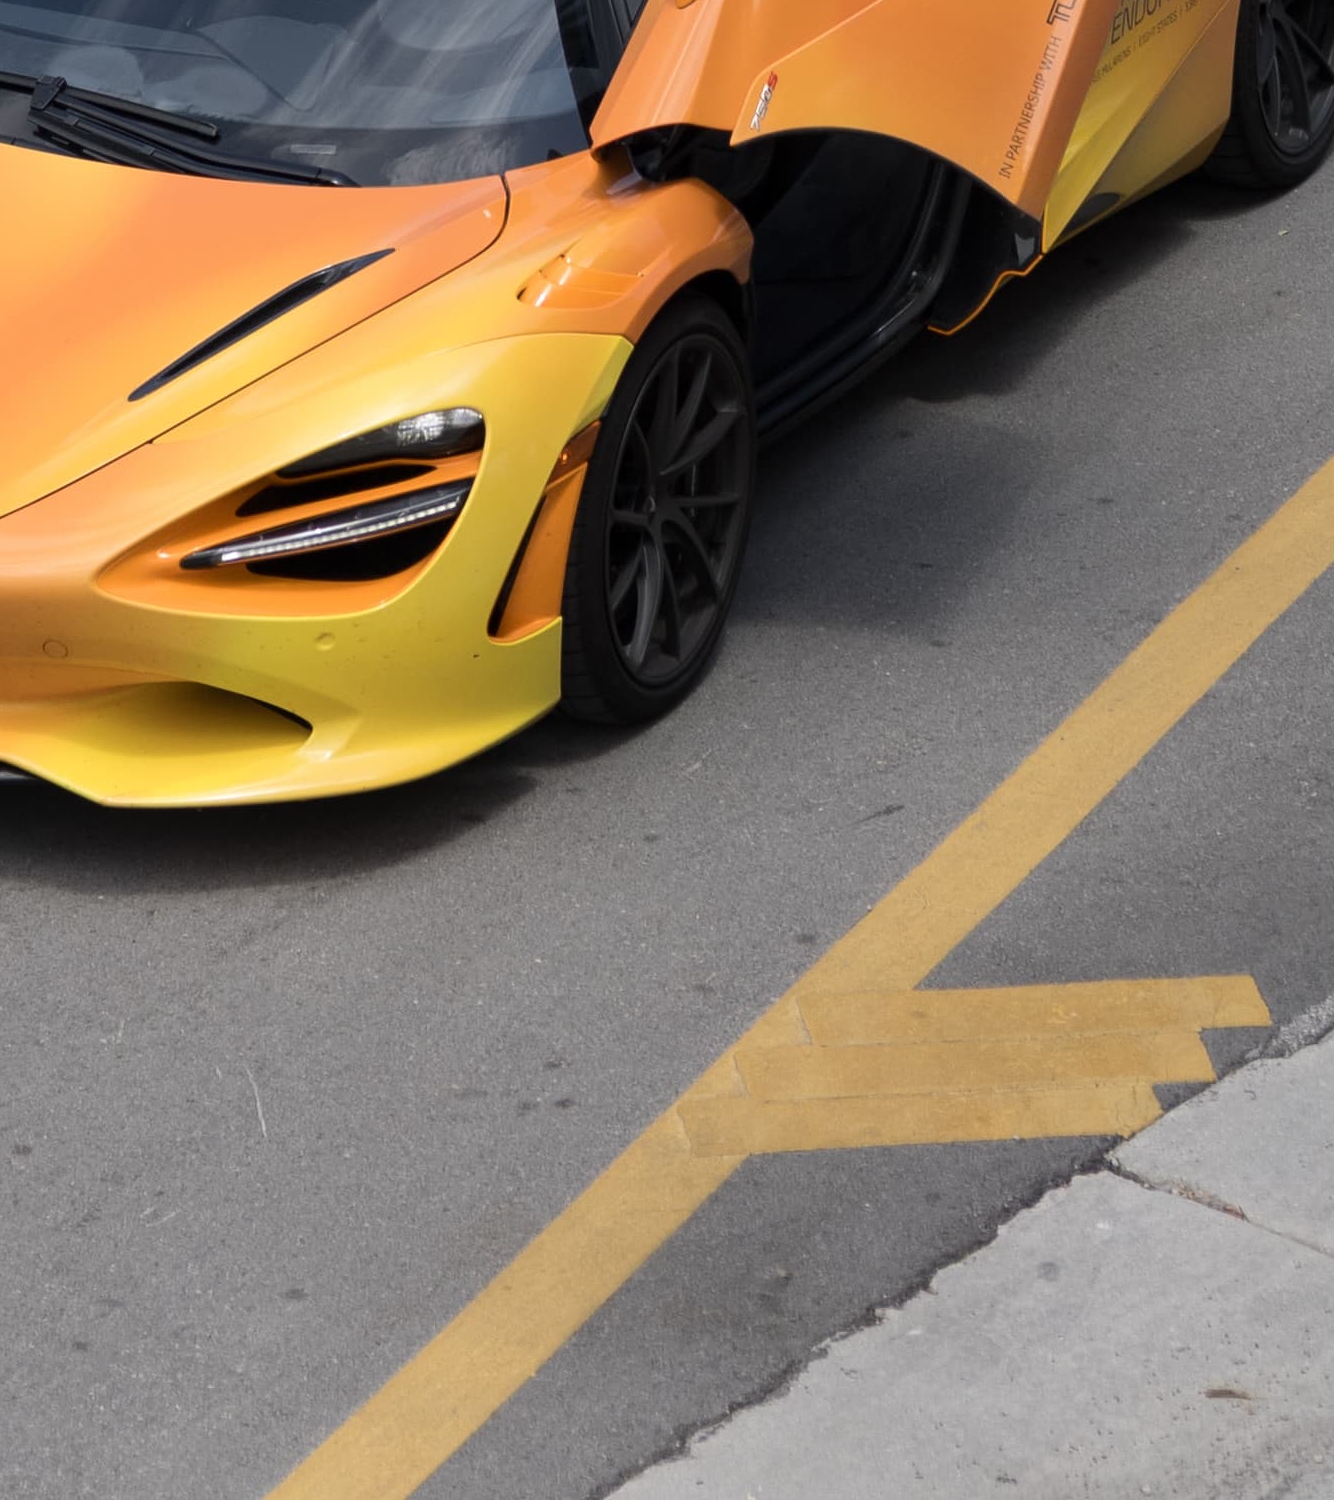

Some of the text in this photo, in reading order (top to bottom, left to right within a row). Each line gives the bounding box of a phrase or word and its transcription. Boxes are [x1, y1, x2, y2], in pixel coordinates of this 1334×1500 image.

[1039, 35, 1062, 72] WITH
[1005, 71, 1046, 161] PARTNERSHIP
[998, 161, 1014, 180] IN
